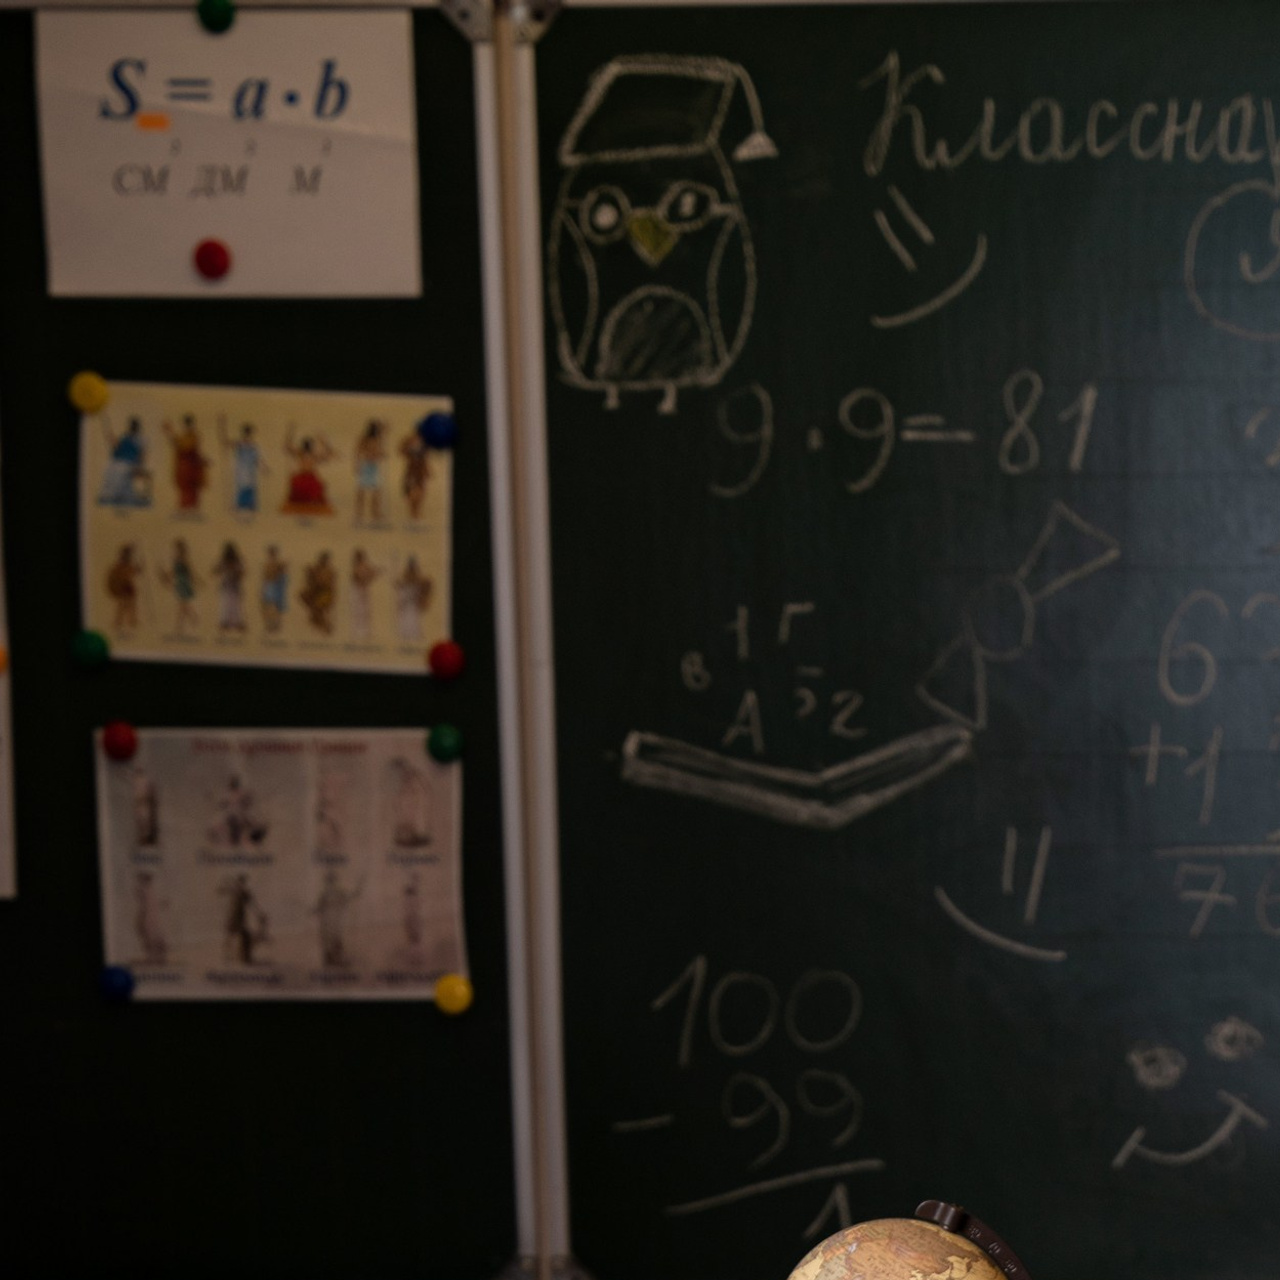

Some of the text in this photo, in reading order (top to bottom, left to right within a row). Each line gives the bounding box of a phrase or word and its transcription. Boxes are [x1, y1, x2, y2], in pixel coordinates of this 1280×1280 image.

[100, 58, 146, 121] S
[232, 78, 269, 120] a
[314, 58, 350, 120] b
[650, 953, 864, 1069] 100
